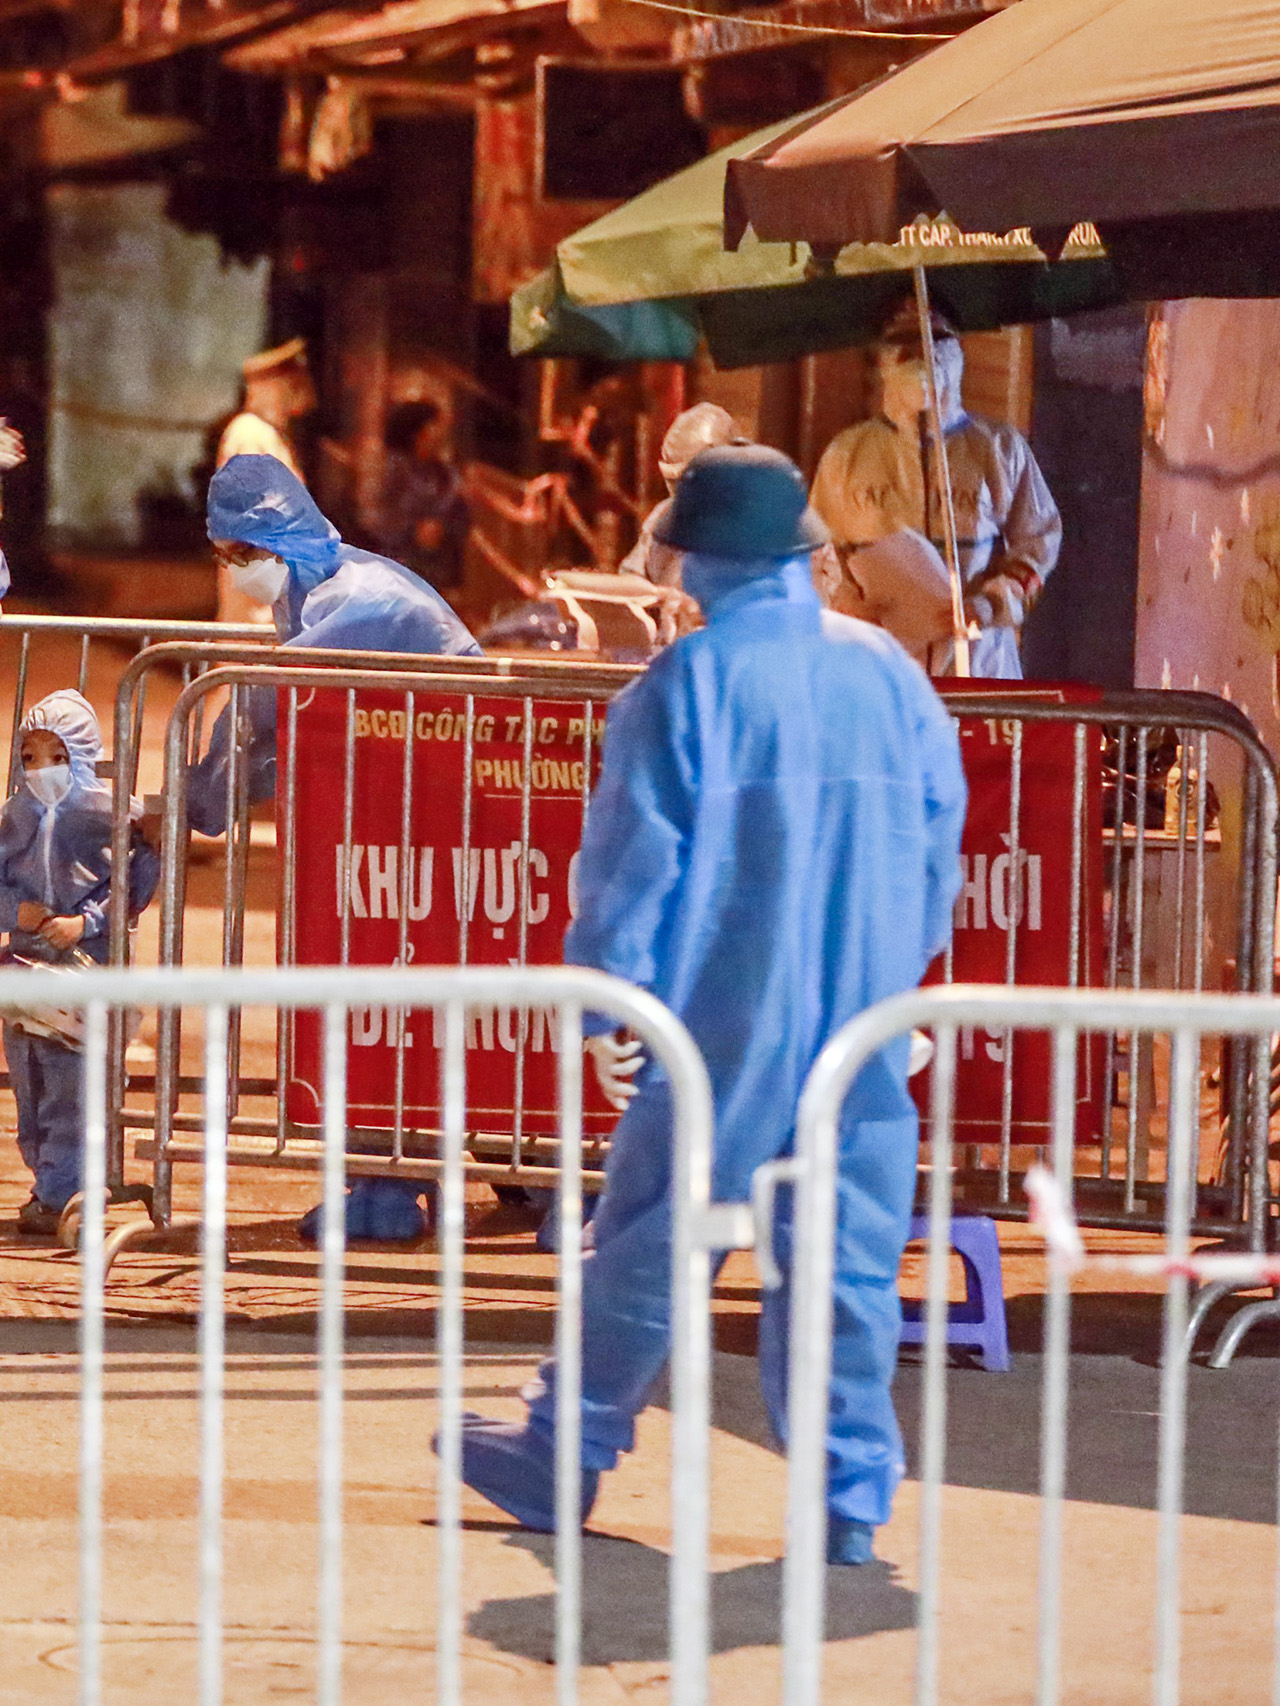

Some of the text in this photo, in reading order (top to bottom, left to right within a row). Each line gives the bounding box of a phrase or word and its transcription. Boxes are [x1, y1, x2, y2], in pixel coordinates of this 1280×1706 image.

[416, 707, 496, 743] CÔNG
[335, 844, 434, 920] KHU
[451, 840, 550, 940] VỰC
